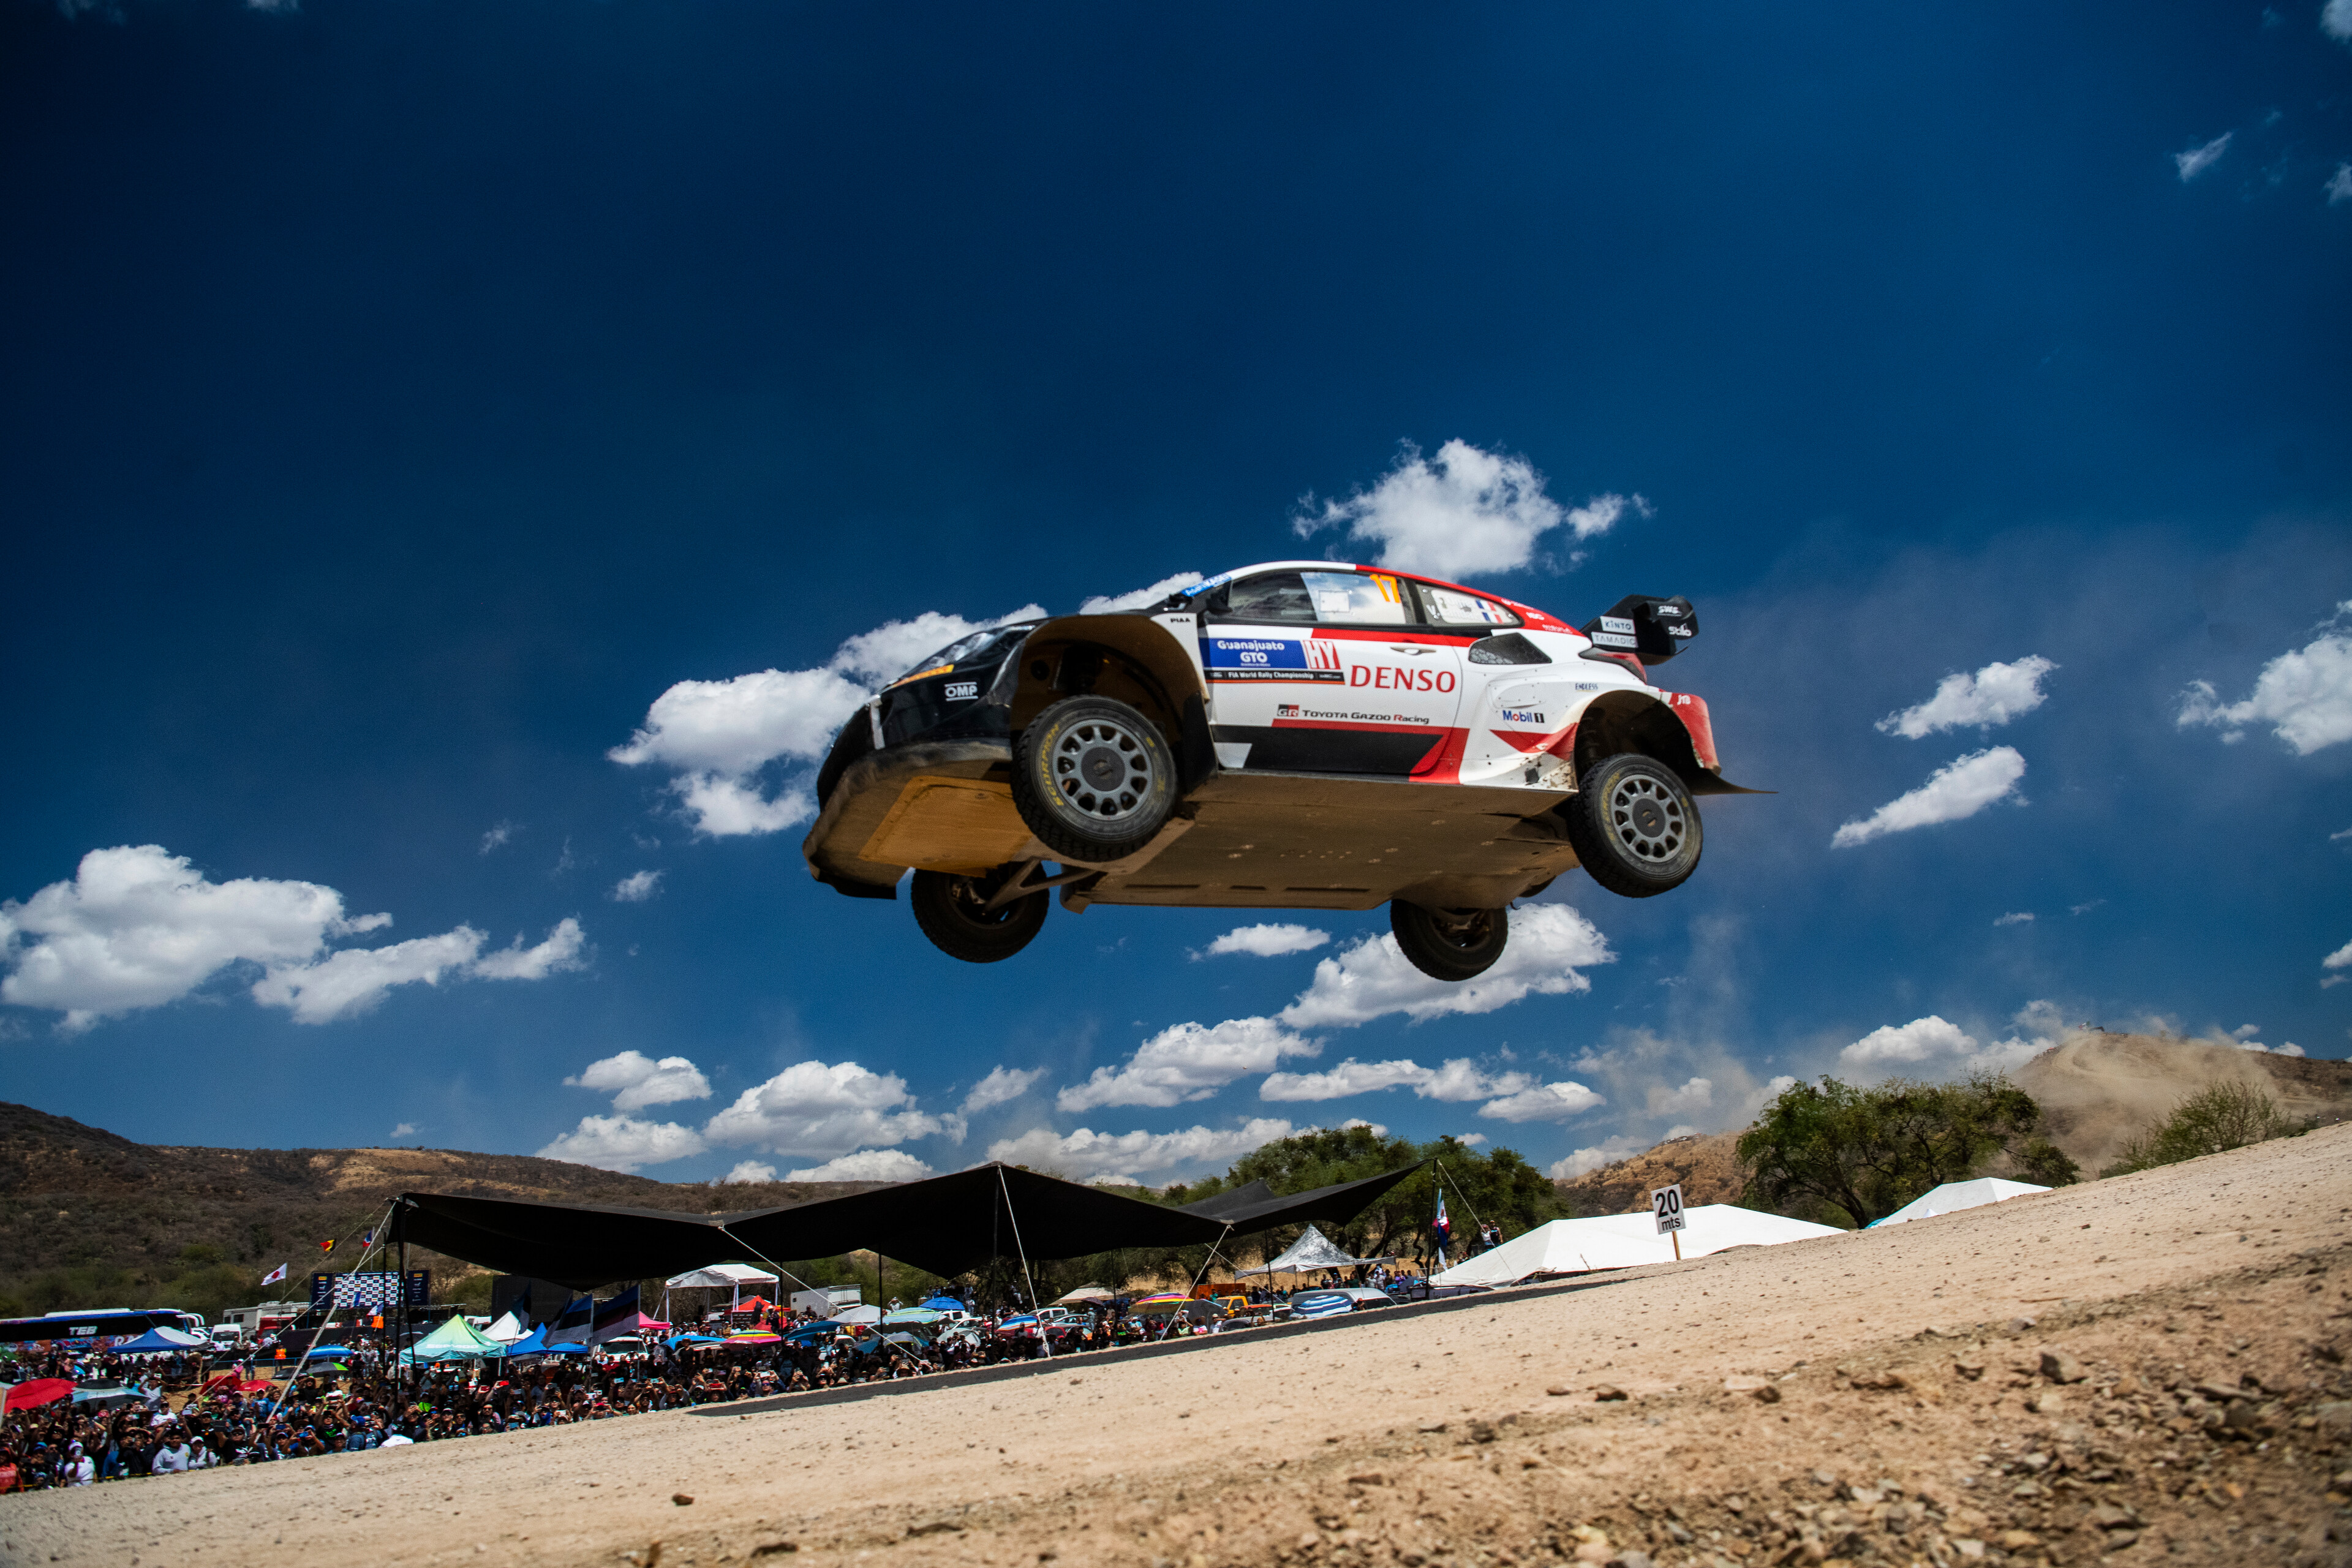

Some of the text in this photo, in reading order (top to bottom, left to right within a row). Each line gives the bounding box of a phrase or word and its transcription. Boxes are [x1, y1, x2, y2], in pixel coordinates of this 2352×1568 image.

[1369, 574, 1401, 603] 17
[1217, 640, 1285, 652] Guanajuato
[1240, 651, 1268, 663] GTO
[1350, 665, 1456, 693] DENSO
[944, 684, 978, 698] OMP
[1393, 714, 1430, 724] Racing
[1502, 710, 1544, 723] Mobil 1
[1655, 1189, 1679, 1218] 20
[1661, 1217, 1681, 1231] mts
[69, 1325, 98, 1335] TEB
